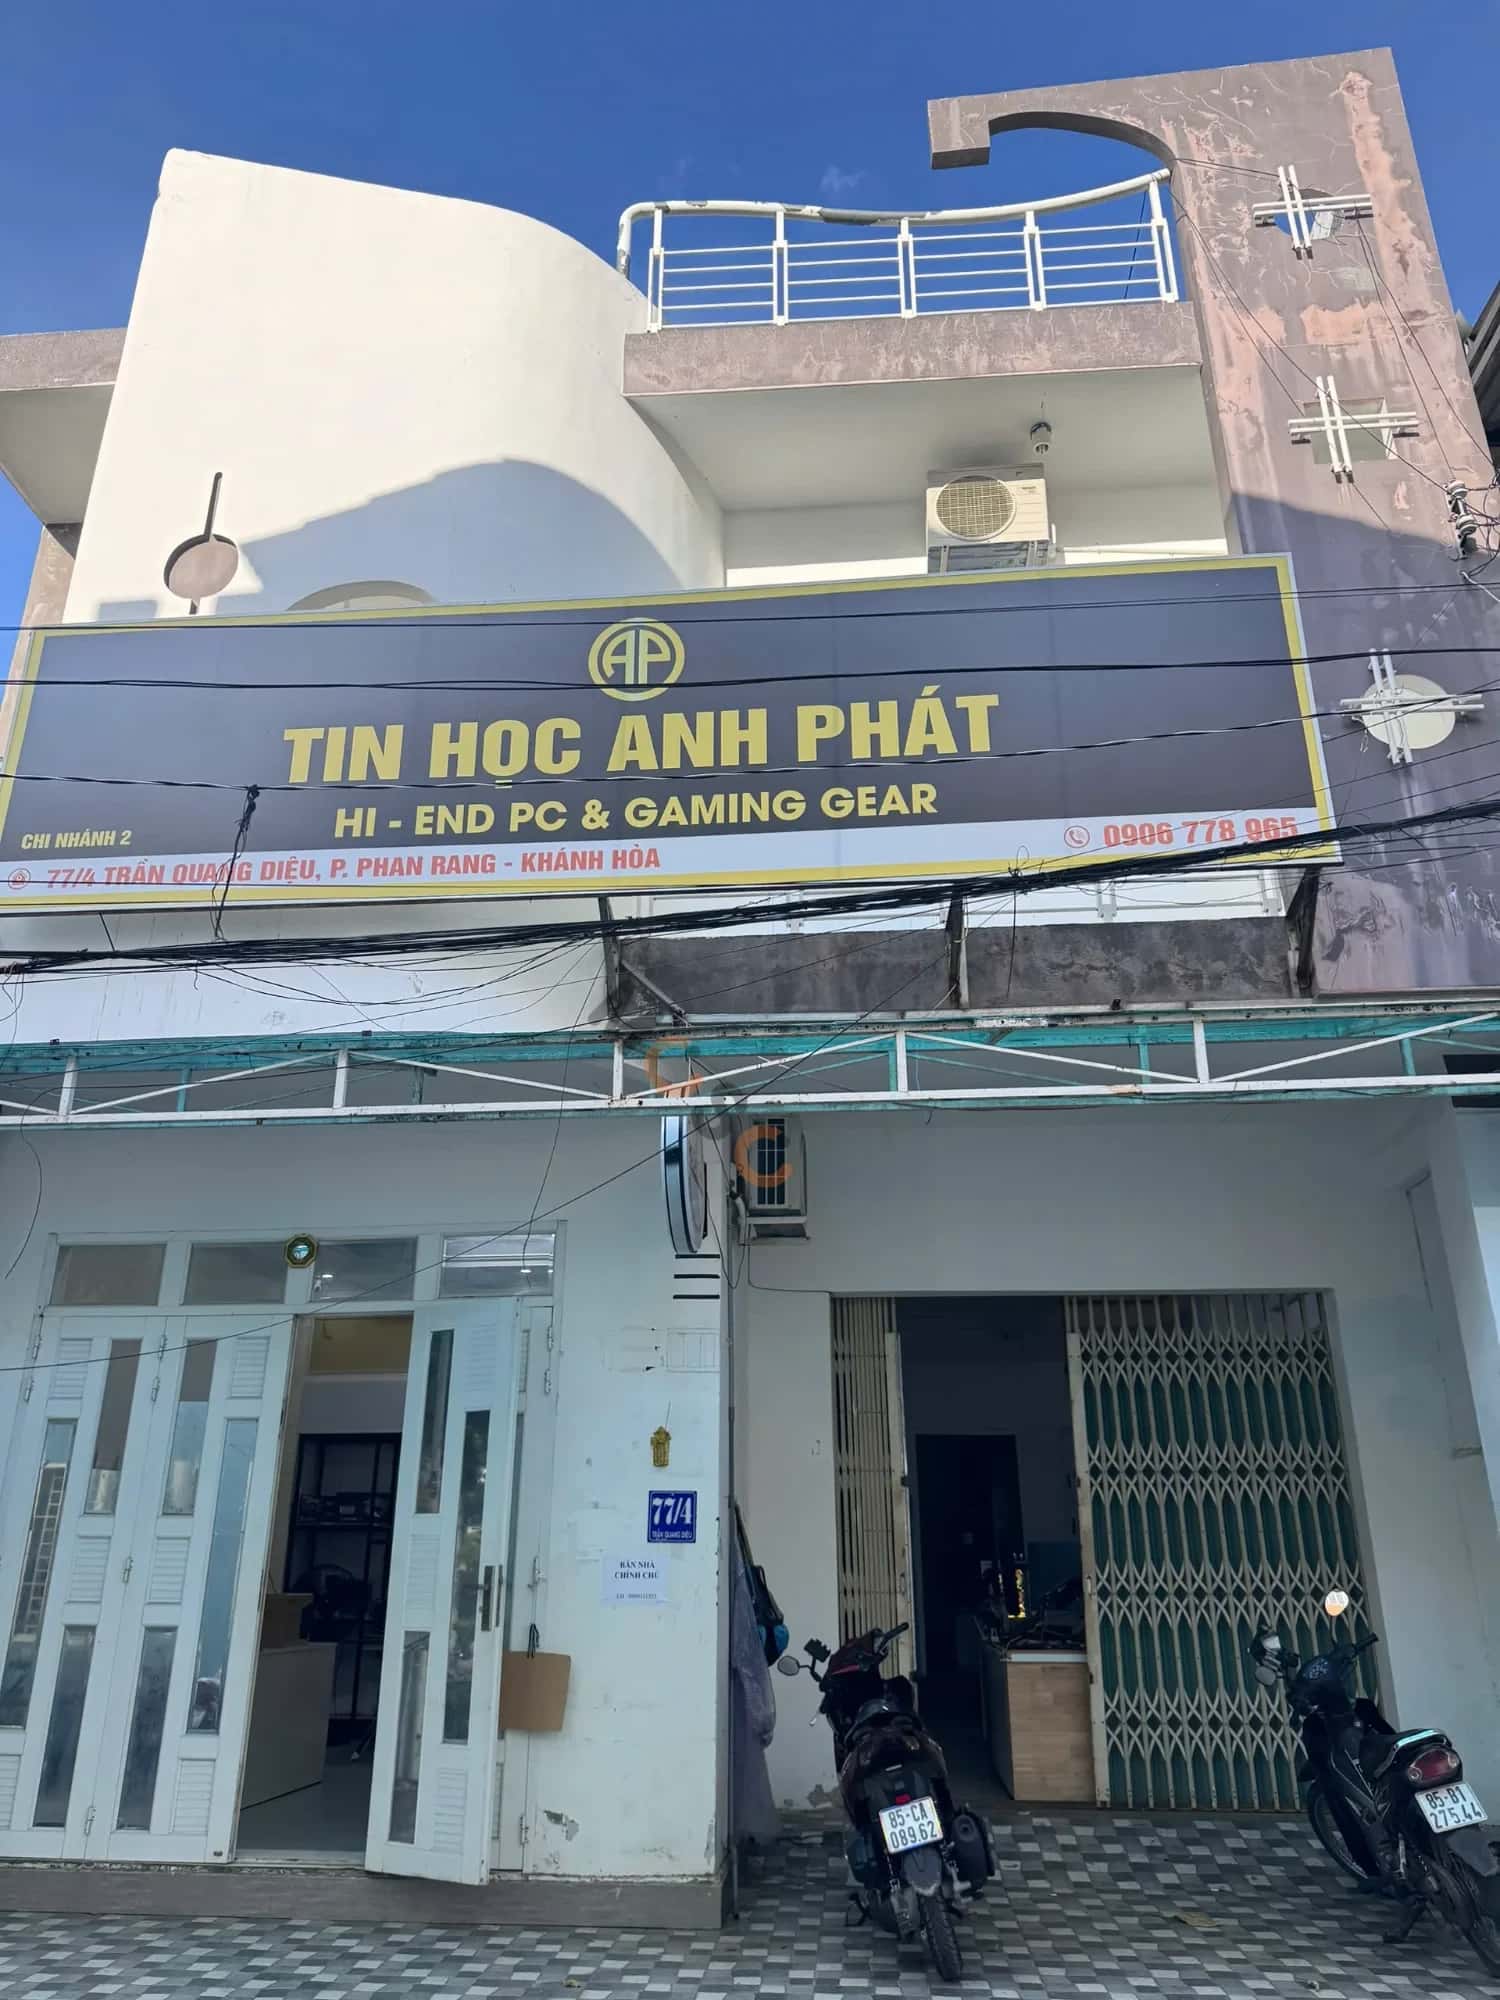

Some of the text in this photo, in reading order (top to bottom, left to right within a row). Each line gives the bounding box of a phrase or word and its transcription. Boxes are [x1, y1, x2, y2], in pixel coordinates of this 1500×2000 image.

[283, 684, 999, 788] TIN HỌC ANH PHÁT
[334, 807, 377, 838] HI
[414, 803, 495, 836] END
[508, 800, 566, 833] PC
[582, 799, 609, 831] &
[624, 789, 807, 829] GAMING
[820, 783, 937, 819] GEAR
[21, 828, 132, 850] CHI NHÁNH 2
[1103, 816, 1298, 849] 0906 778 965
[47, 867, 96, 888] 77/4
[104, 858, 165, 885] TRẦN
[172, 861, 252, 884] QUANG
[260, 856, 321, 883] DIỆU,
[330, 858, 348, 879] P.
[356, 855, 424, 878] PHAN
[431, 853, 497, 876] RANG
[521, 847, 604, 873] KHÁNH
[611, 843, 661, 870] HÒA
[652, 1497, 692, 1525] 77/4
[1425, 1786, 1467, 1809] 85-B1
[888, 1802, 929, 1829] 85-CA
[1430, 1801, 1482, 1829] 275.44
[889, 1820, 937, 1849] 089.62
